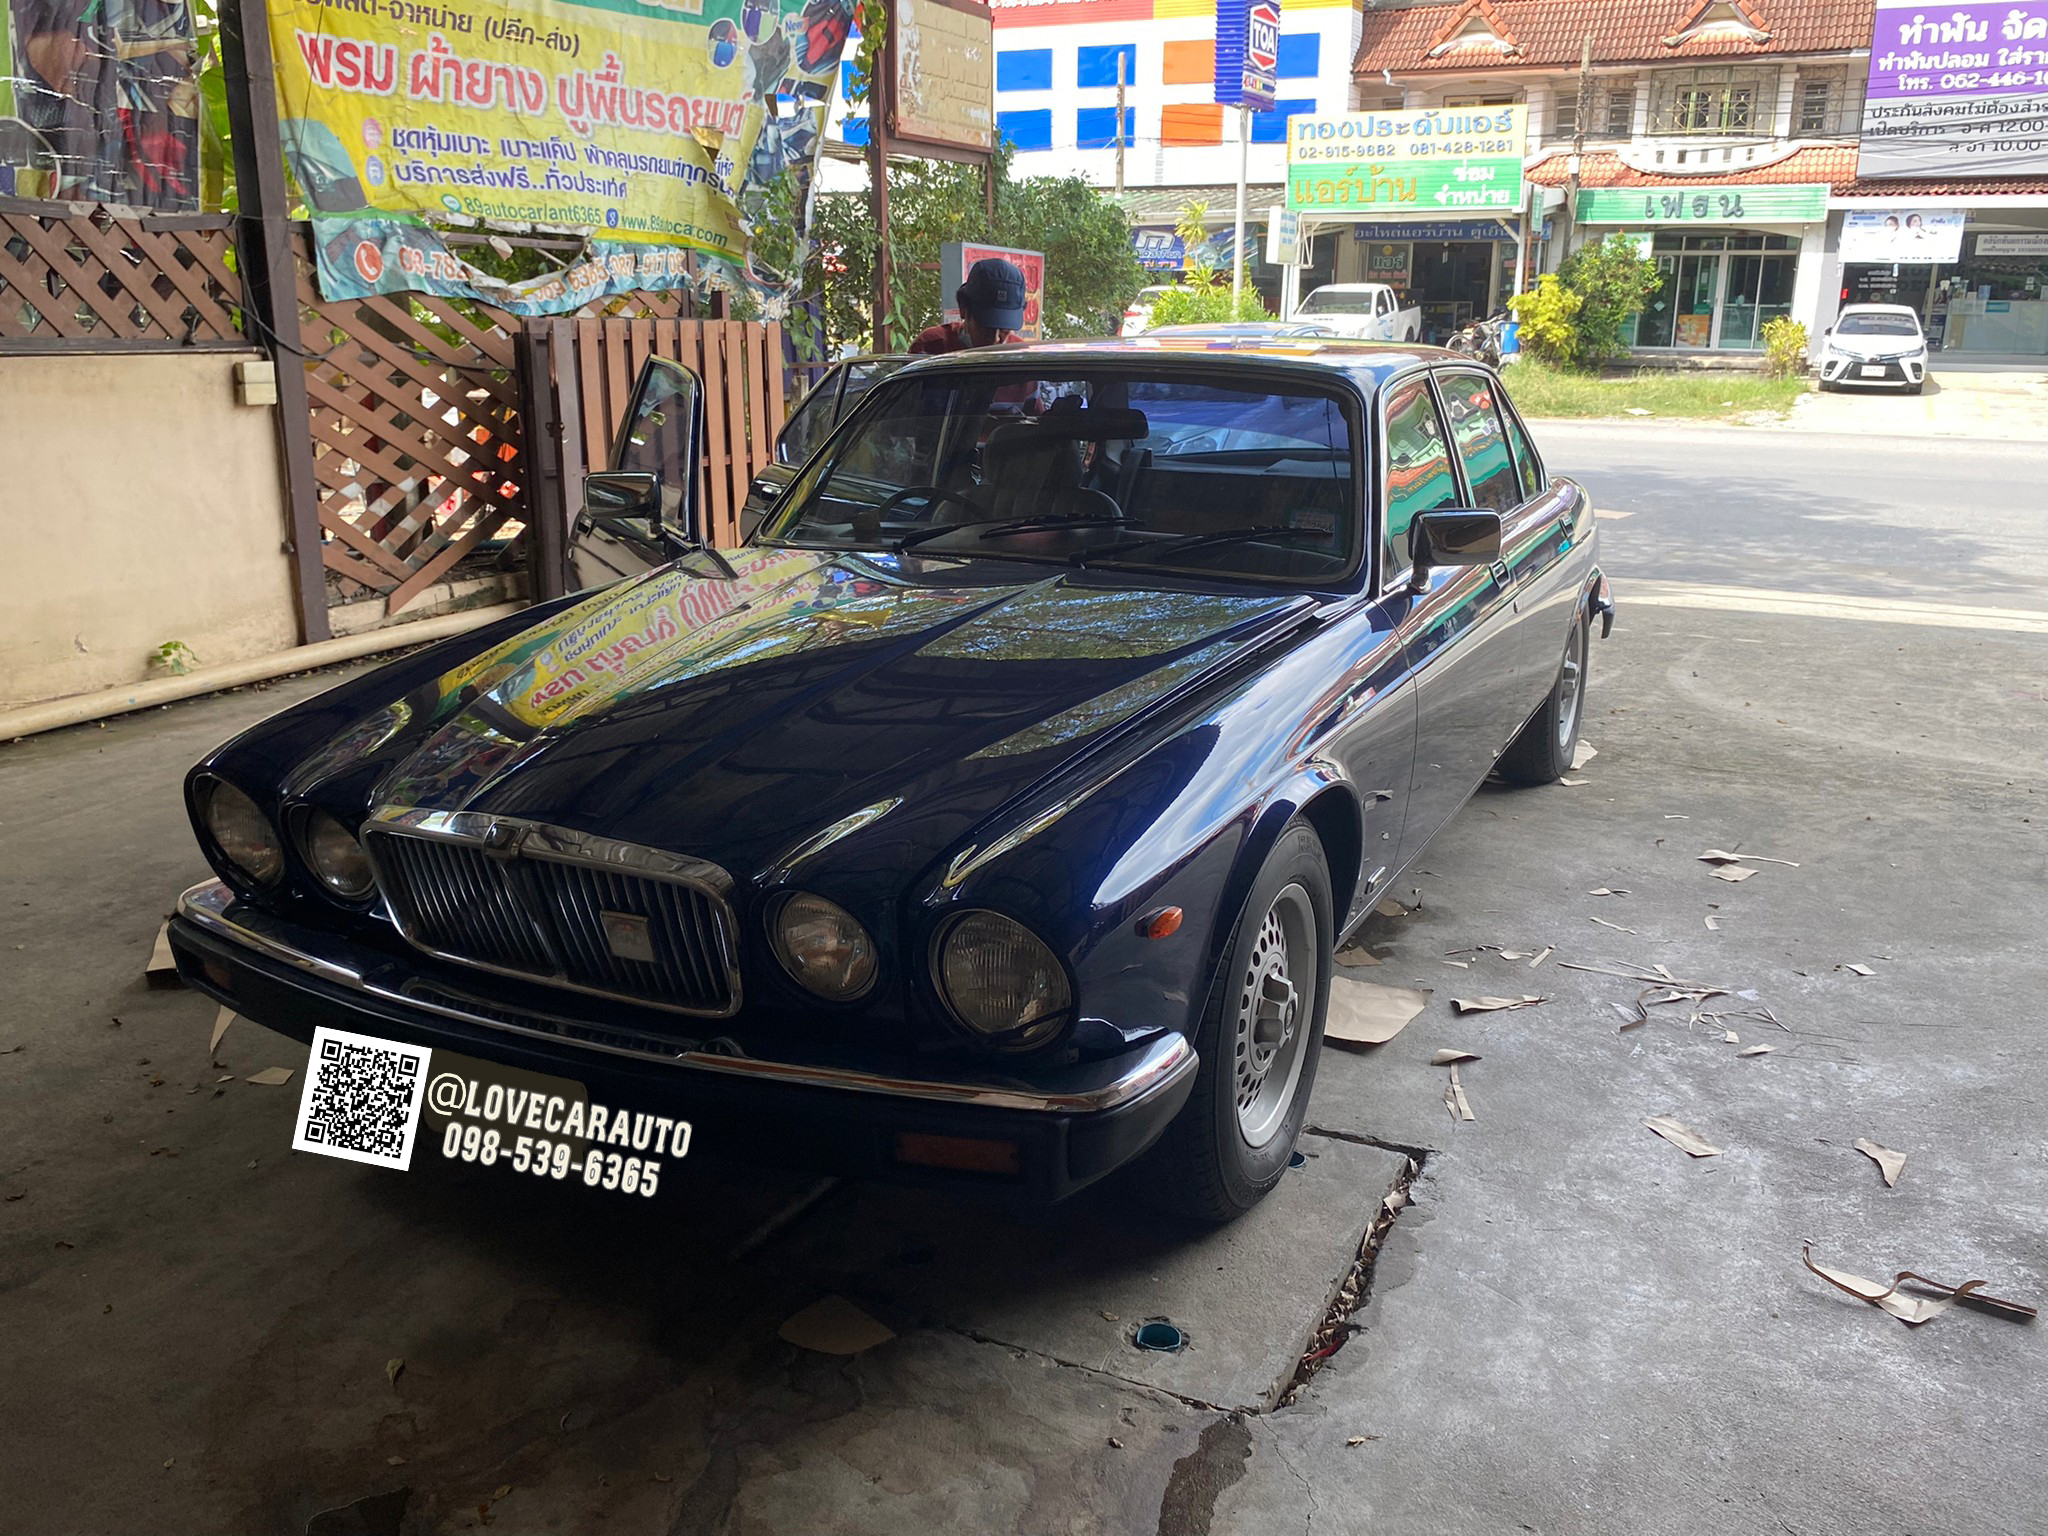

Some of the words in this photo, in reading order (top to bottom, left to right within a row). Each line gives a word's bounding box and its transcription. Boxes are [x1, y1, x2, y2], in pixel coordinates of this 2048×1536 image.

[484, 16, 580, 58] (ปลีก-ส่ง)
[1253, 21, 1275, 54] TOA
[1898, 12, 1989, 46] ทำฟัน
[2002, 9, 2048, 41] จัด
[297, 34, 394, 92] พรม
[410, 36, 544, 111] ผ้ายาง
[1877, 51, 1990, 72] ทำฟันปลอม
[1997, 46, 2048, 67] ใส่รา
[1898, 73, 1934, 91] โทร.
[1298, 108, 1514, 140] ทองประดับแอร์
[392, 126, 490, 157] ชุดหุ้มเบาะ
[501, 136, 577, 162] เบาะแค็ป
[1409, 140, 1514, 155] 081-428-1281
[1294, 164, 1417, 204] แอร์บ้าน
[1453, 160, 1495, 182] ซ่อม
[1433, 184, 1511, 206] จำหน่าย
[1644, 191, 1745, 218] เฟรน
[1373, 252, 1406, 269] แอร์
